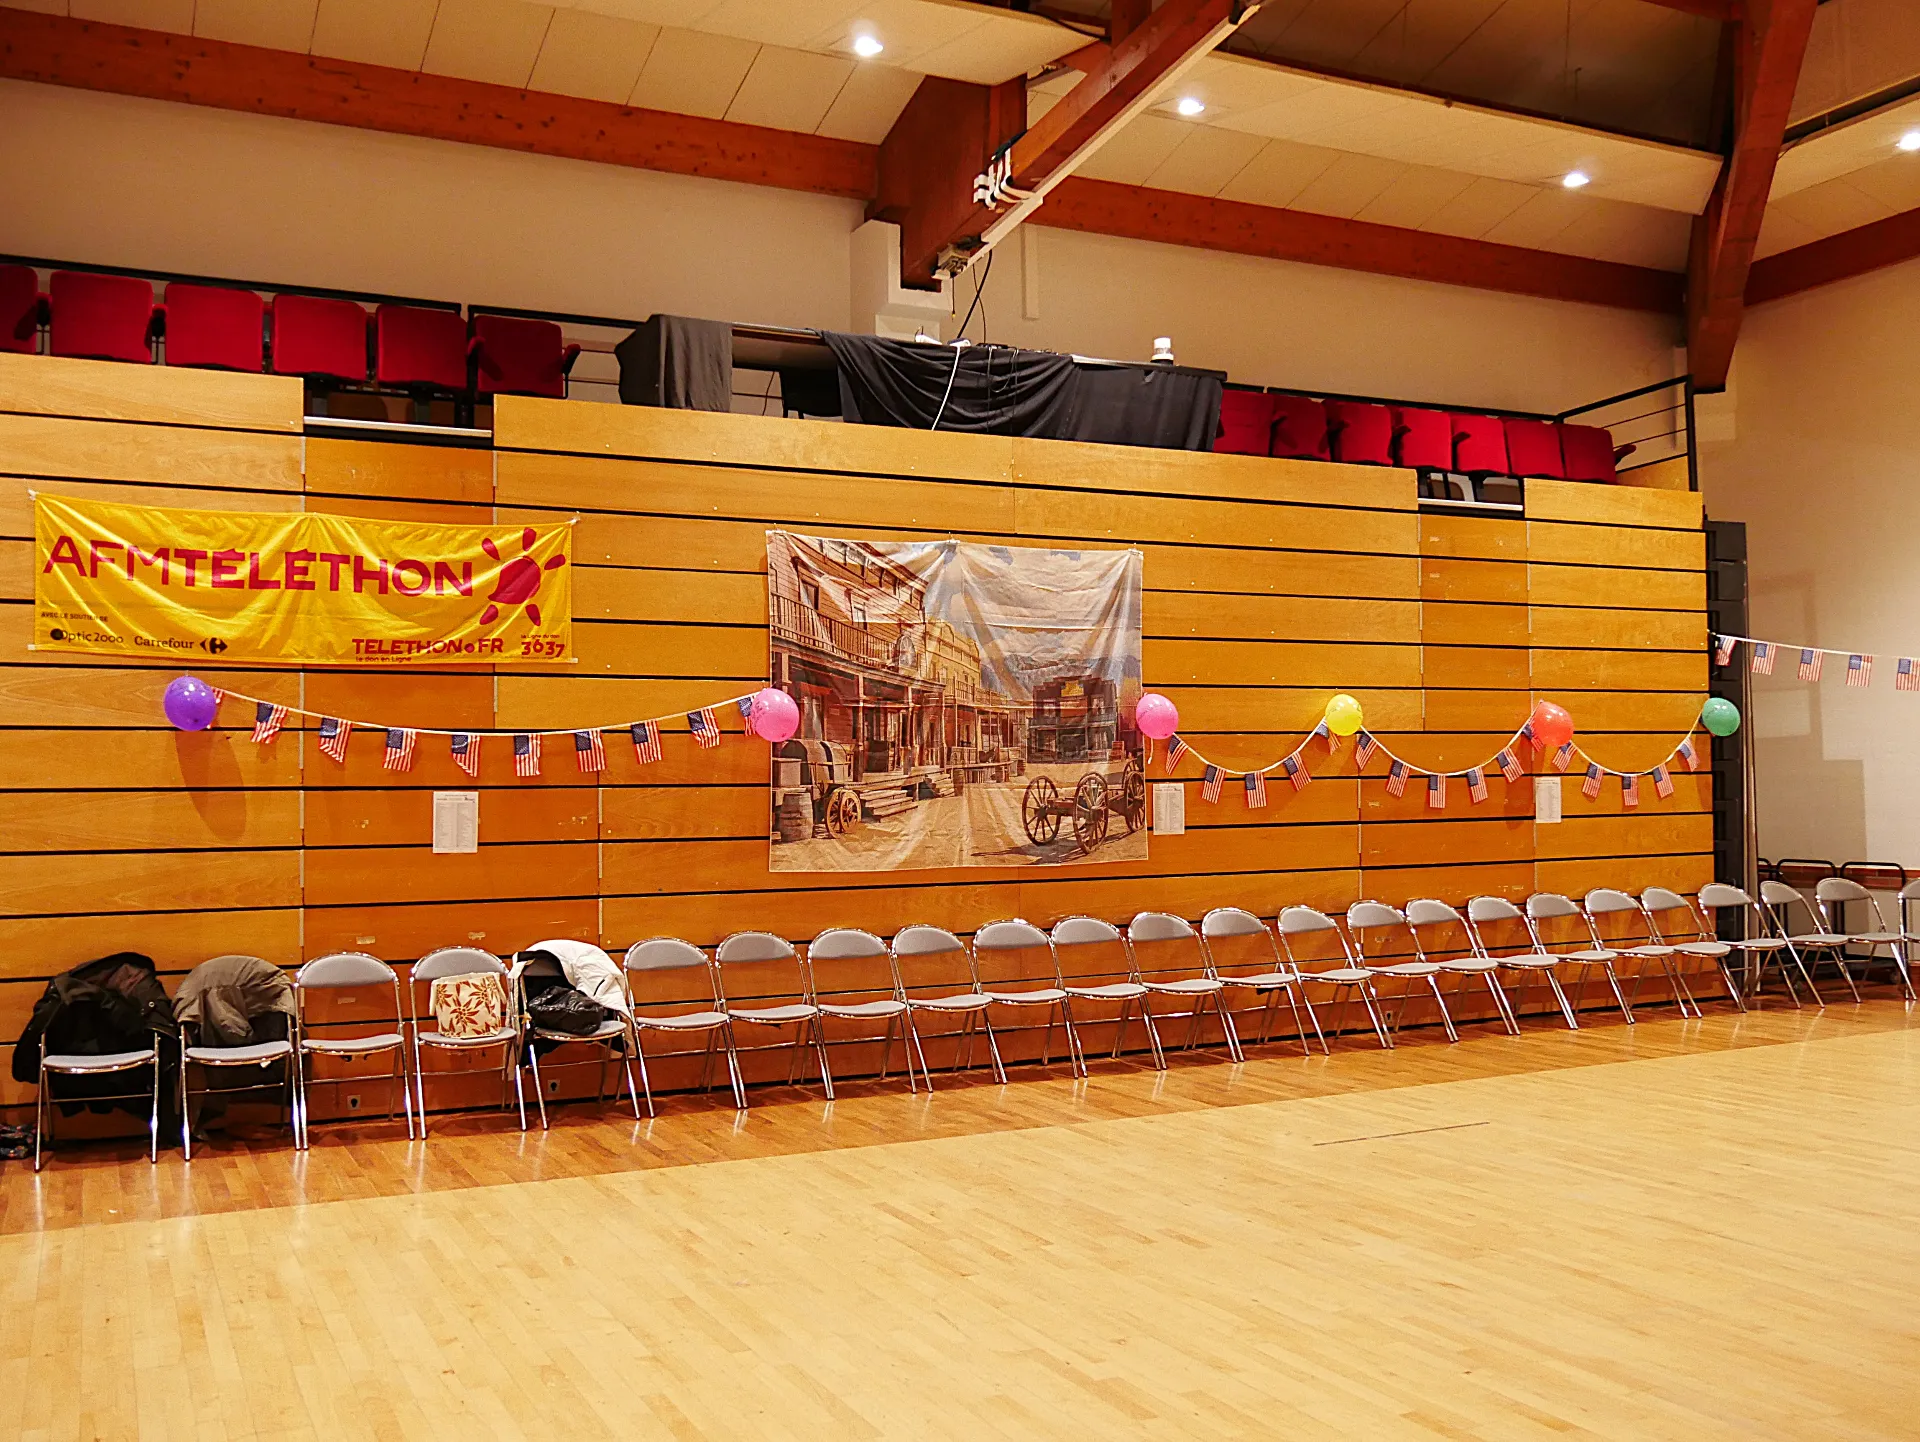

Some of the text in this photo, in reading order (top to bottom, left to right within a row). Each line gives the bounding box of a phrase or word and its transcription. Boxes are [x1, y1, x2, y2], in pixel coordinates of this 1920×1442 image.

[94, 633, 124, 643] 2000
[134, 635, 195, 649] Carrefour
[521, 638, 566, 658] 3637
